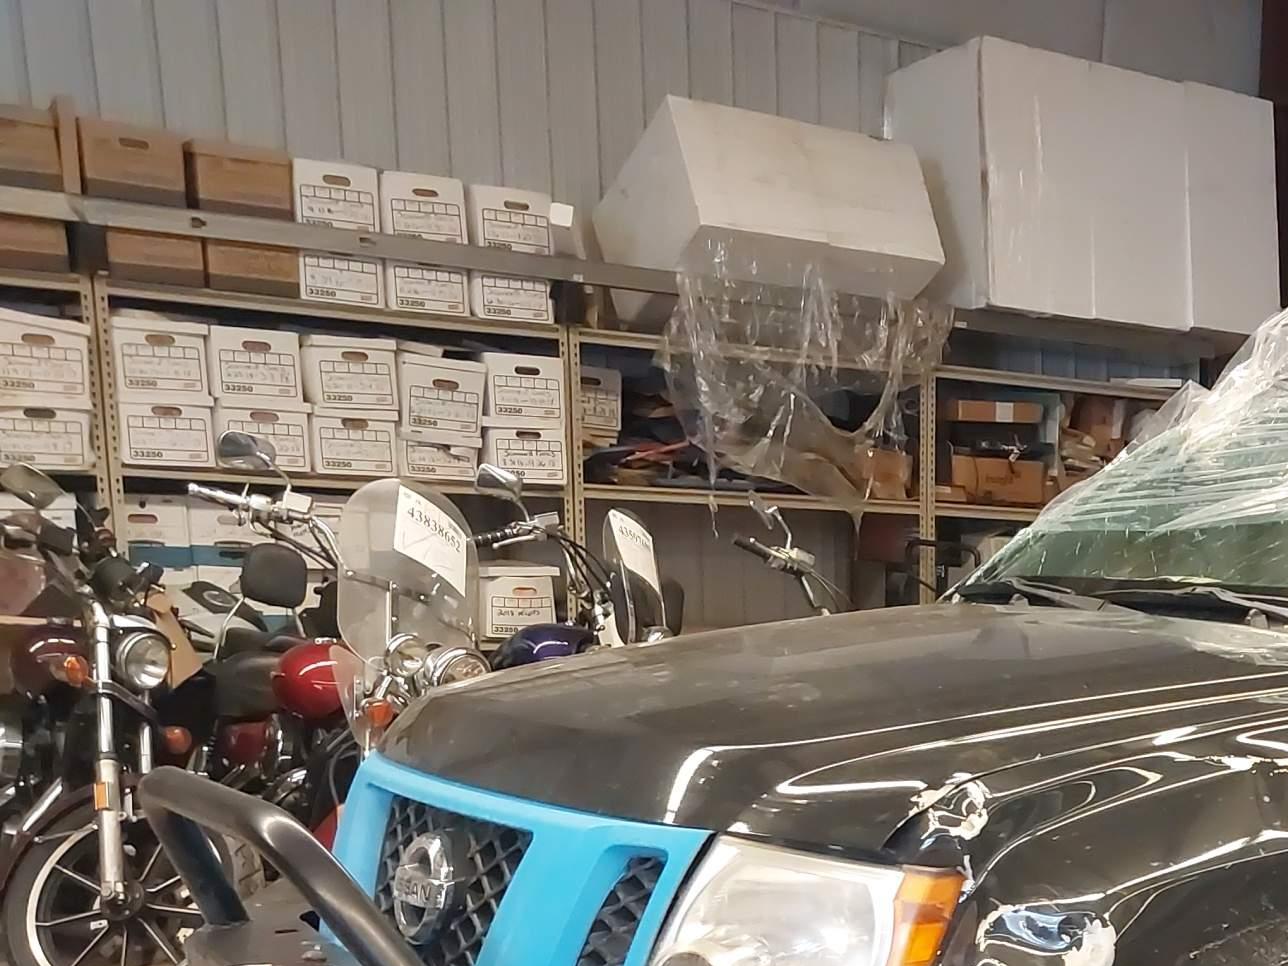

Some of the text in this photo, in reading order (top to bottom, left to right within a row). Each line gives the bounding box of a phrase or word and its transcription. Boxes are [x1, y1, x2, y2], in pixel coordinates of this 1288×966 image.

[307, 287, 337, 298] 33250
[497, 406, 523, 415] 33250
[132, 450, 163, 459] 33250
[407, 507, 461, 553] 43838652
